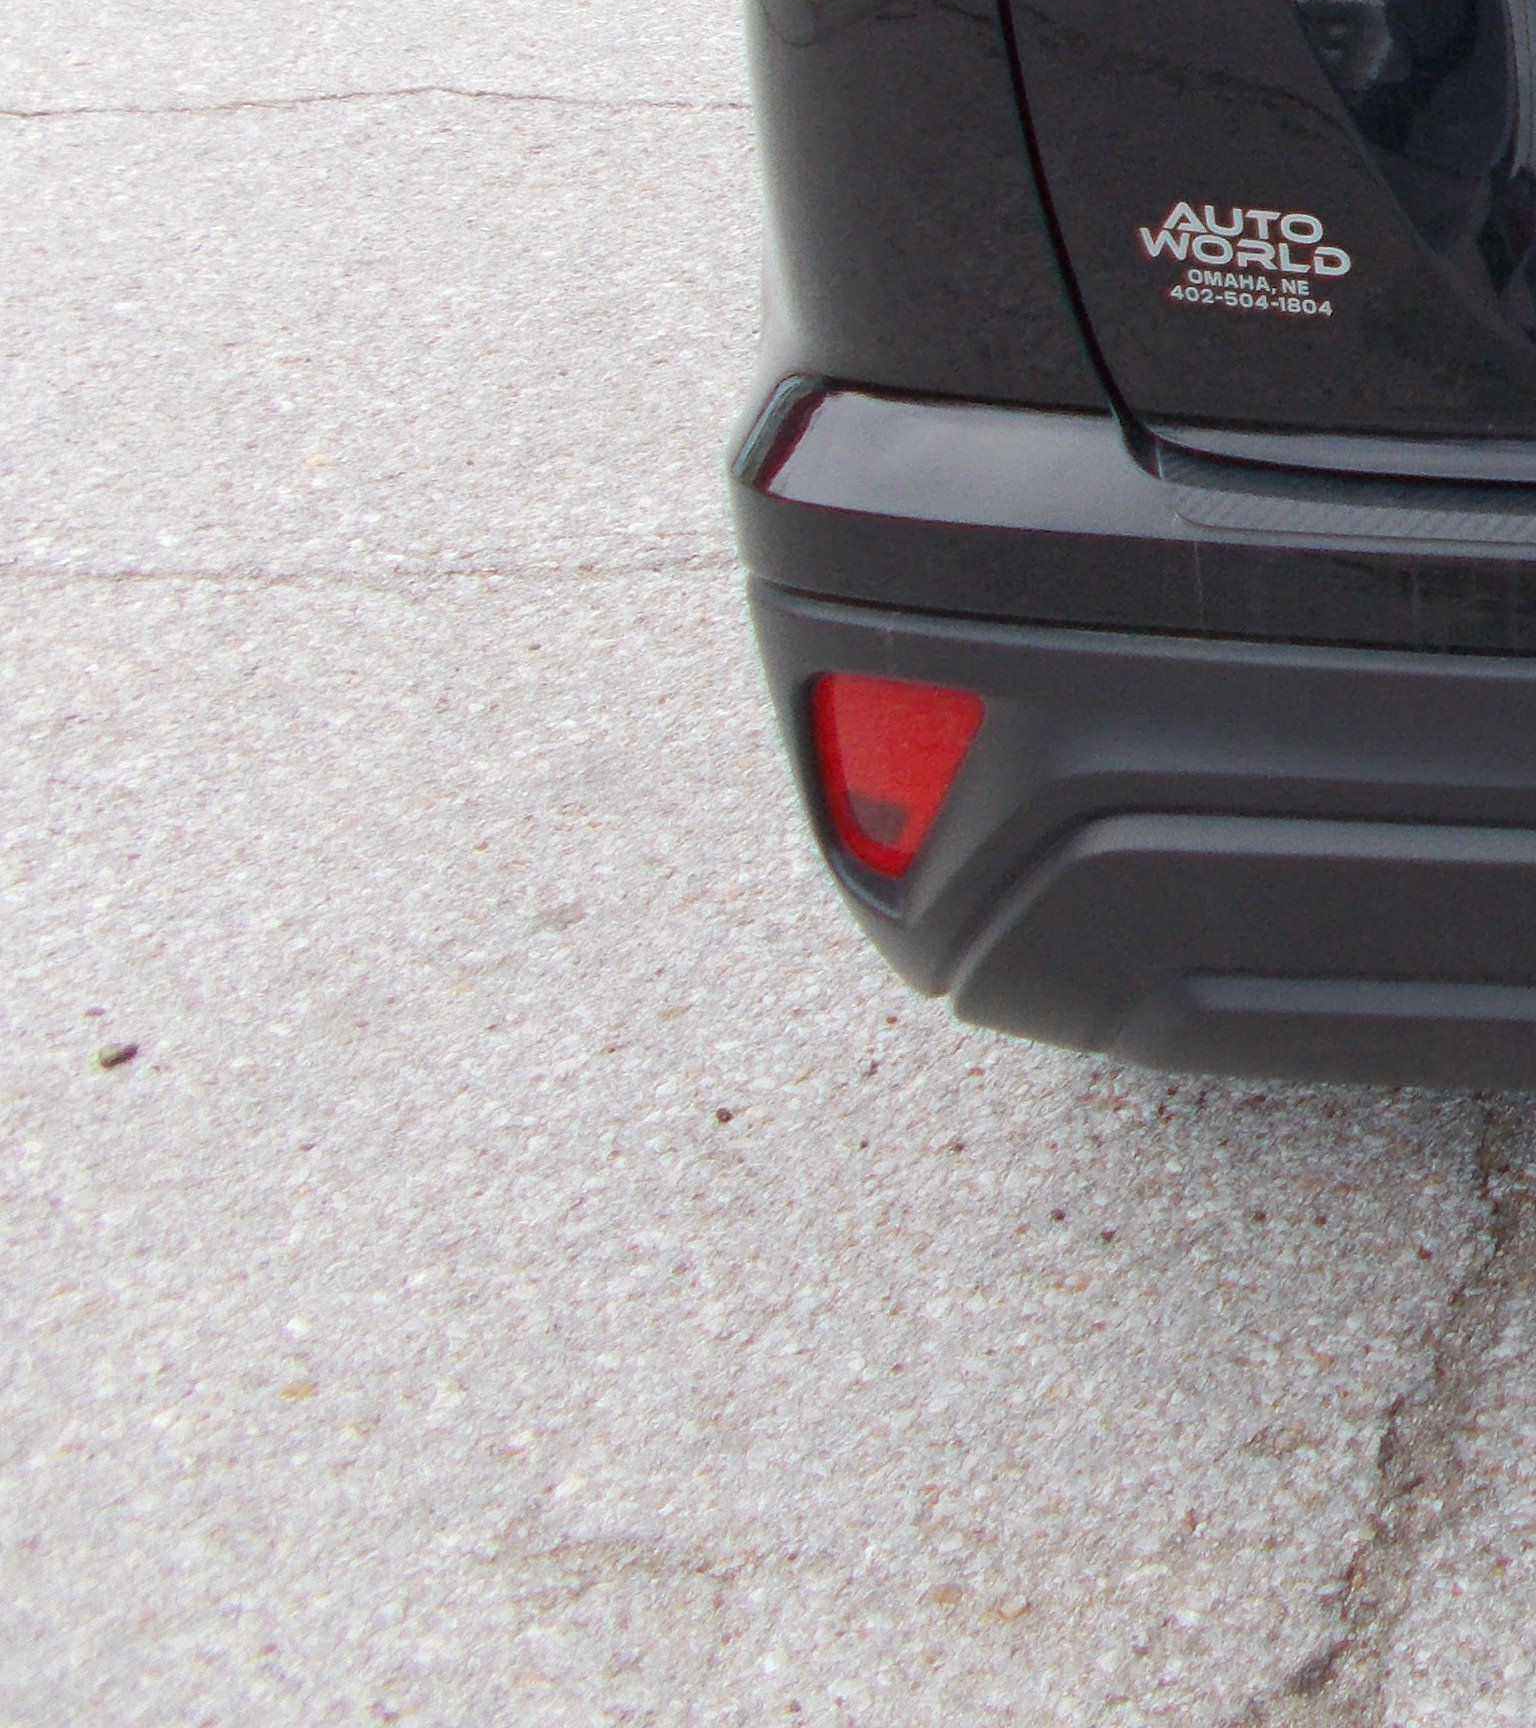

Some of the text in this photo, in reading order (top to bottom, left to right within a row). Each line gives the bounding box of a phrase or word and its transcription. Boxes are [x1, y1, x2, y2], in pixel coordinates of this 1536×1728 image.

[1163, 201, 1323, 244] AUTO
[1139, 227, 1351, 276] WORLD
[1187, 268, 1310, 296] OMAHA, NE
[1170, 285, 1334, 317] 402-504-1804
